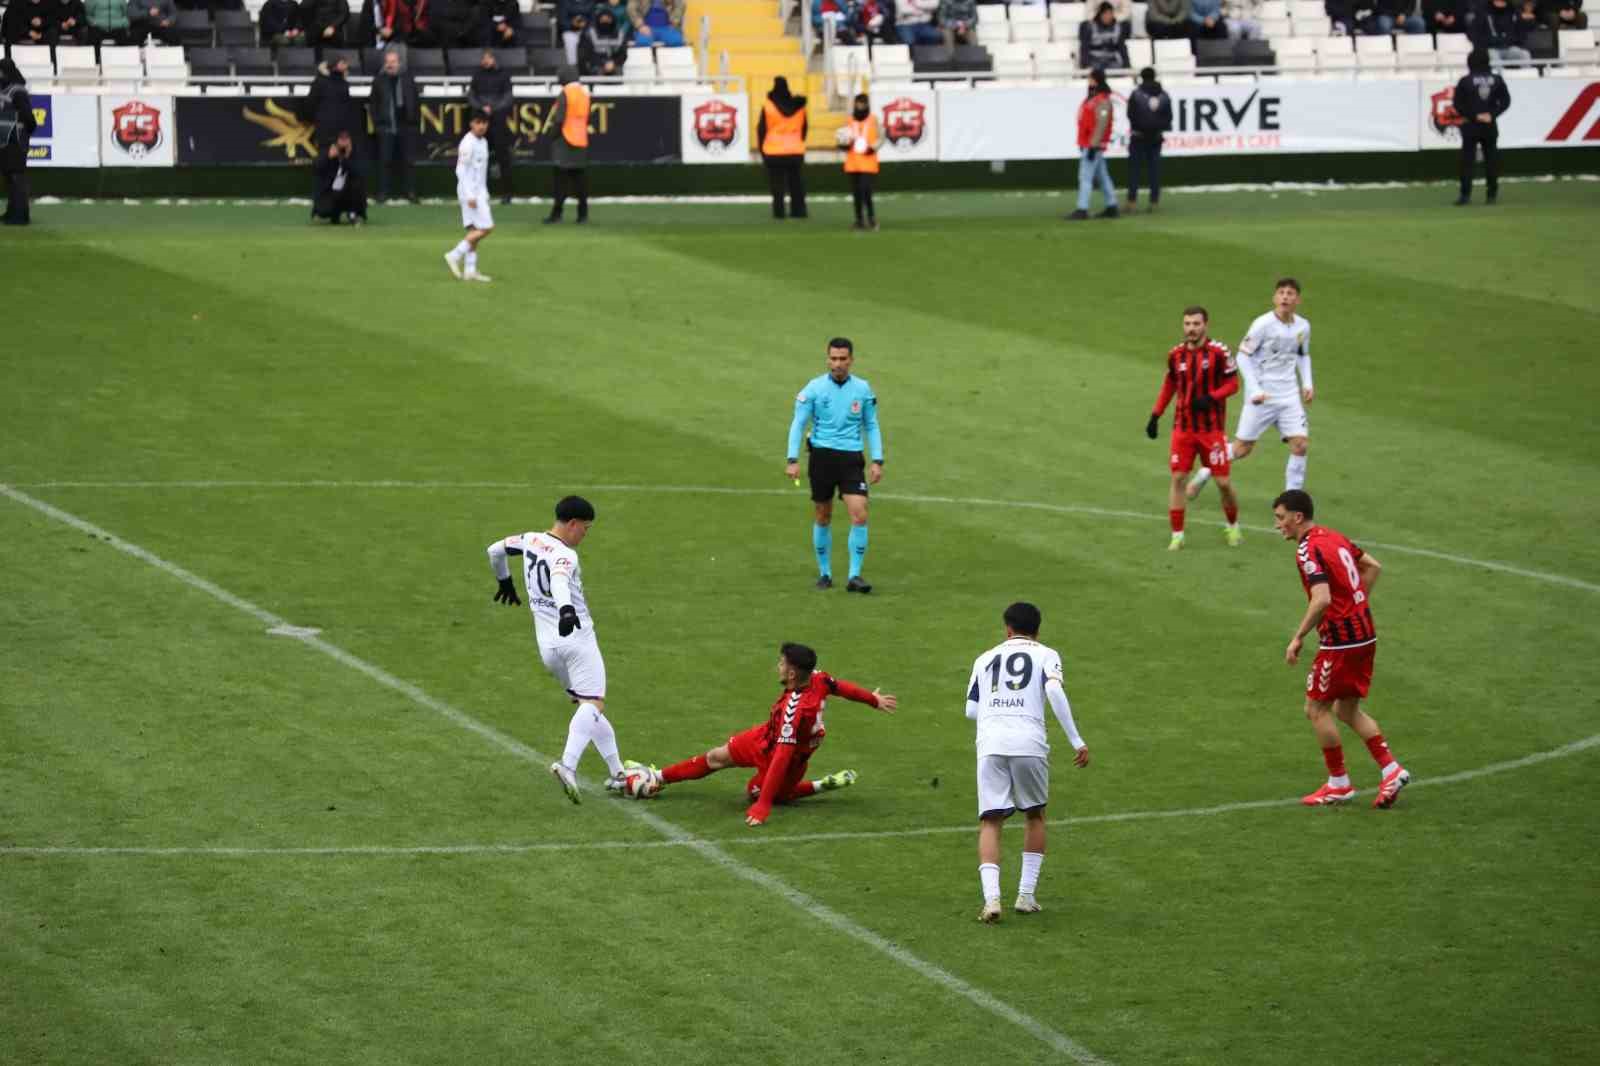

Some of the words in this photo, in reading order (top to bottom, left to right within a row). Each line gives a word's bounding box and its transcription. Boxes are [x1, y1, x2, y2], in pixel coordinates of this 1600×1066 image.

[1178, 88, 1281, 132] IRVE
[526, 550, 554, 598] 70
[1338, 546, 1360, 590] 8
[985, 652, 1033, 693] 19
